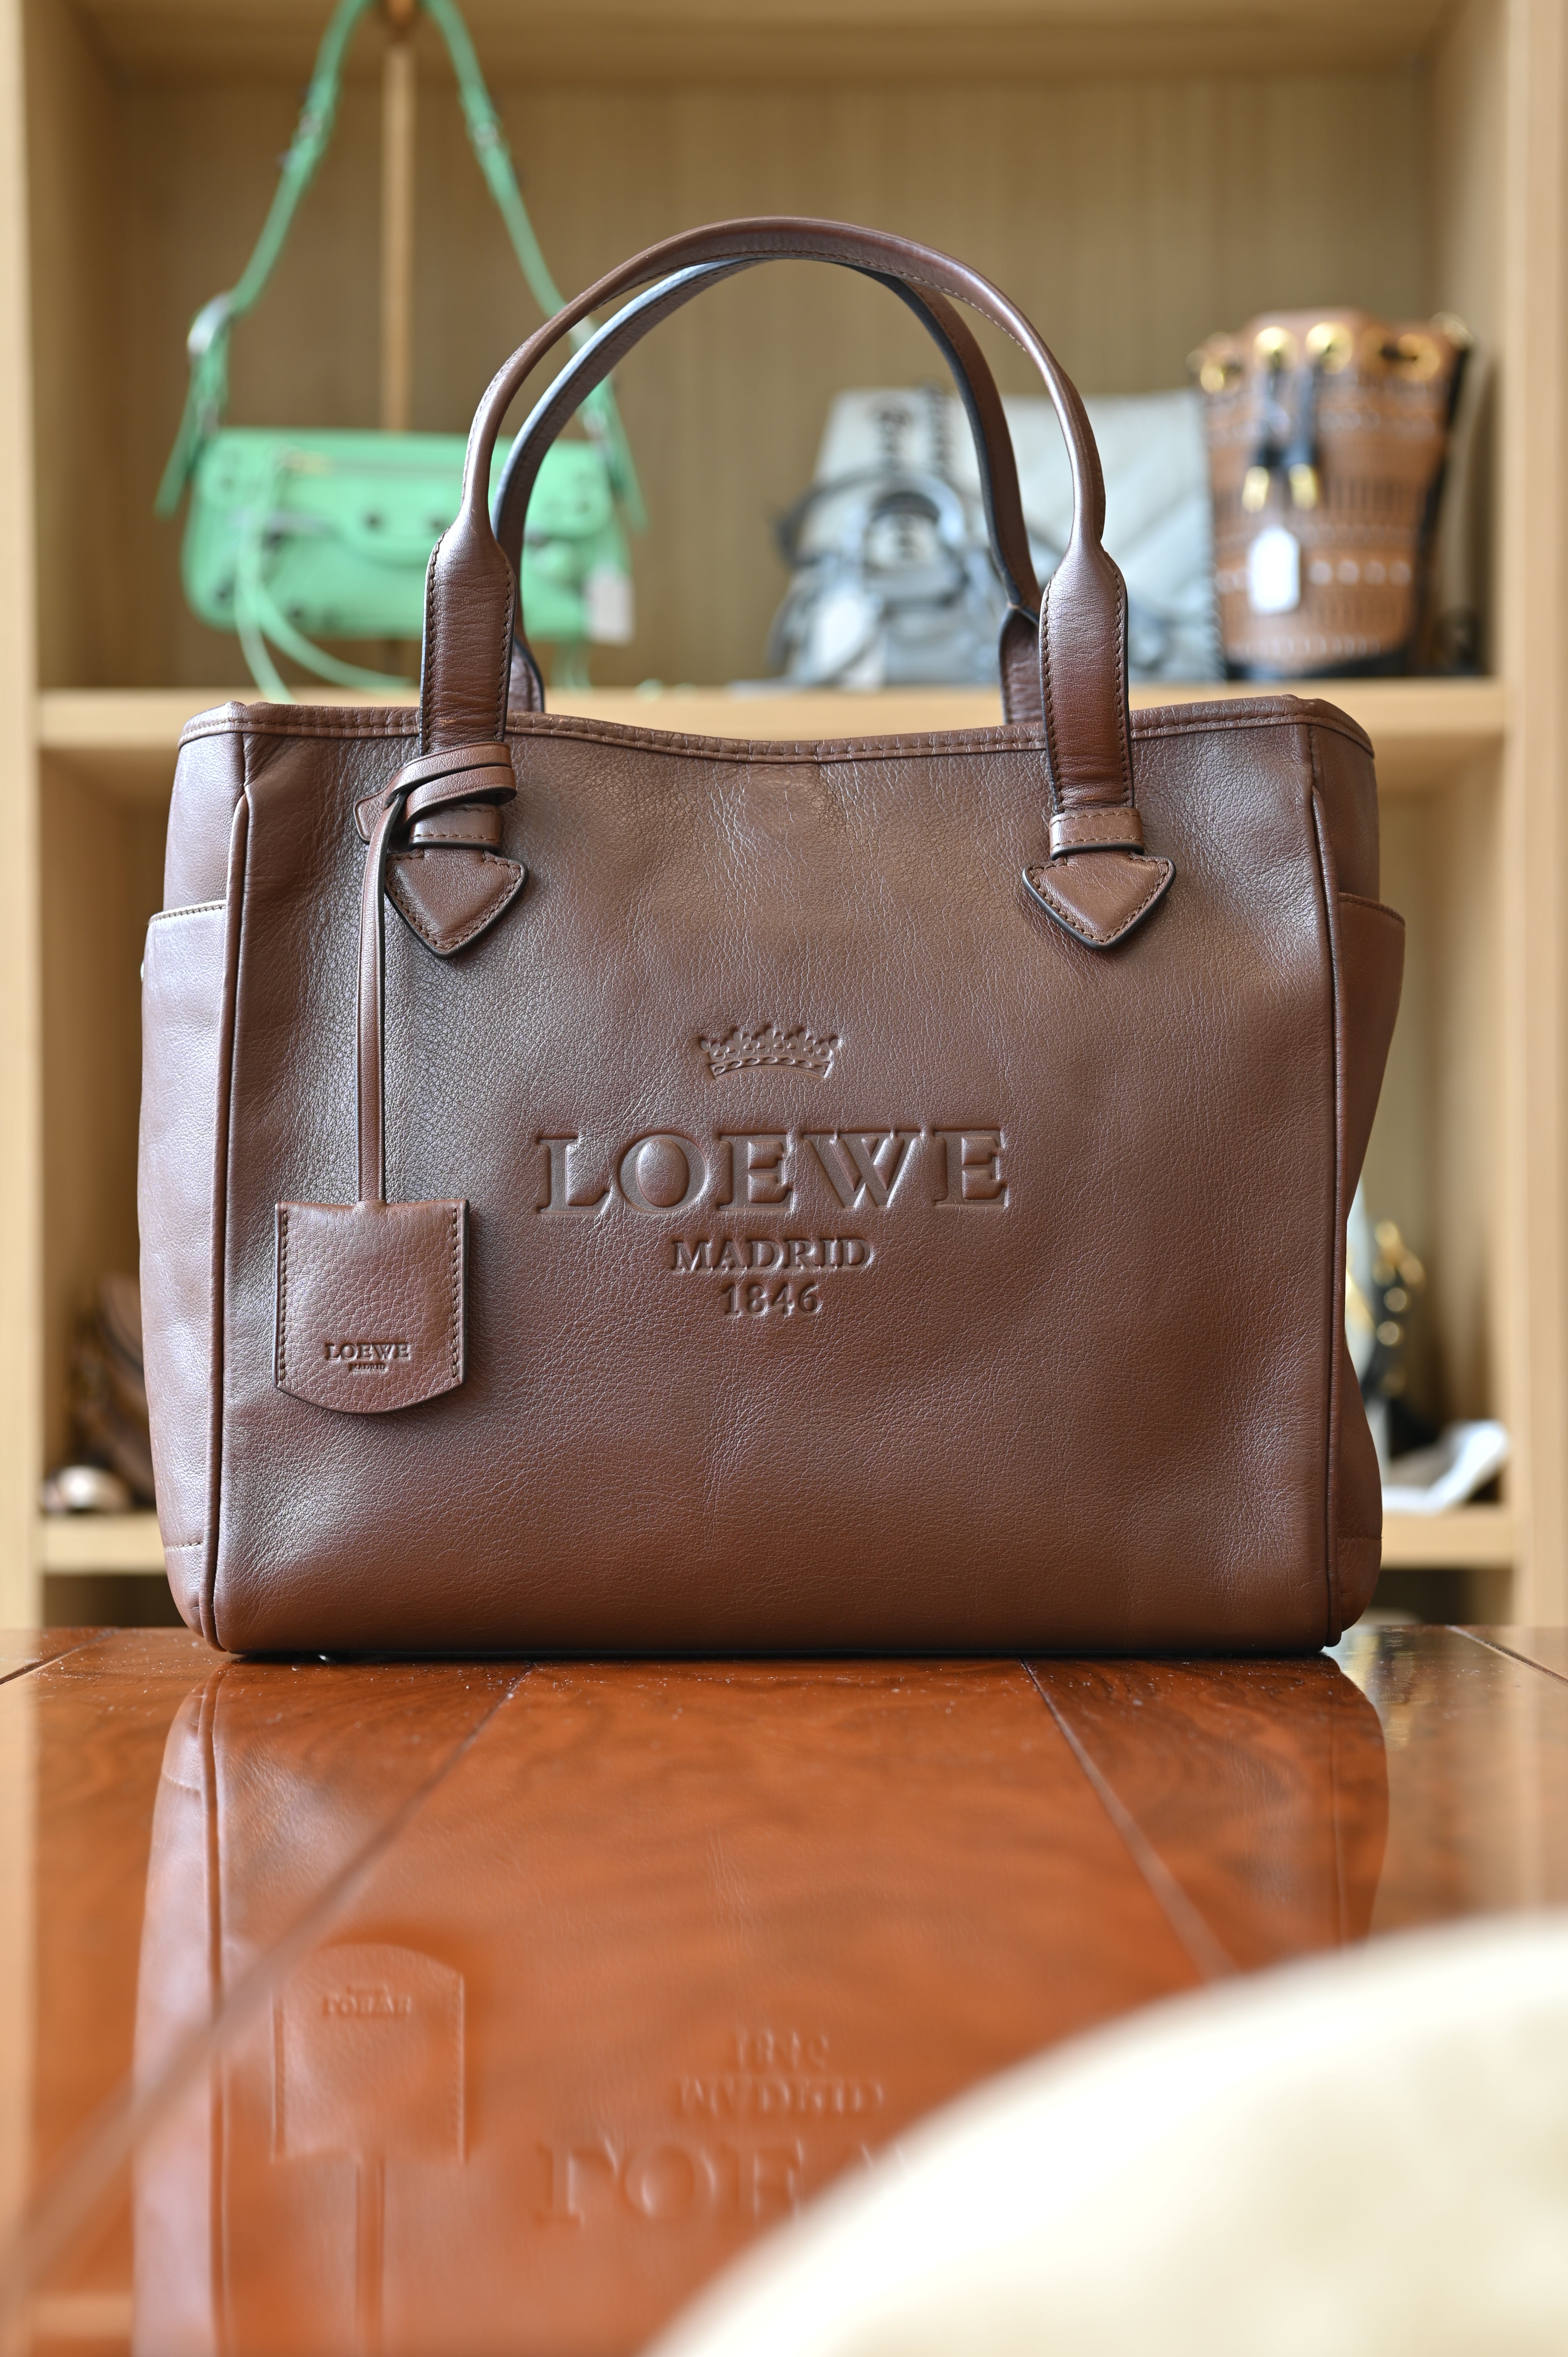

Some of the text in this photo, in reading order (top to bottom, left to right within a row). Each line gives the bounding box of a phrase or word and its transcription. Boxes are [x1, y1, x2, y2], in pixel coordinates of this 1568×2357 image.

[535, 1127, 1009, 1214] LOEWE
[670, 1236, 874, 1271] MADRID
[722, 1282, 822, 1317] 1846
[325, 1342, 411, 1362] LOEWE
